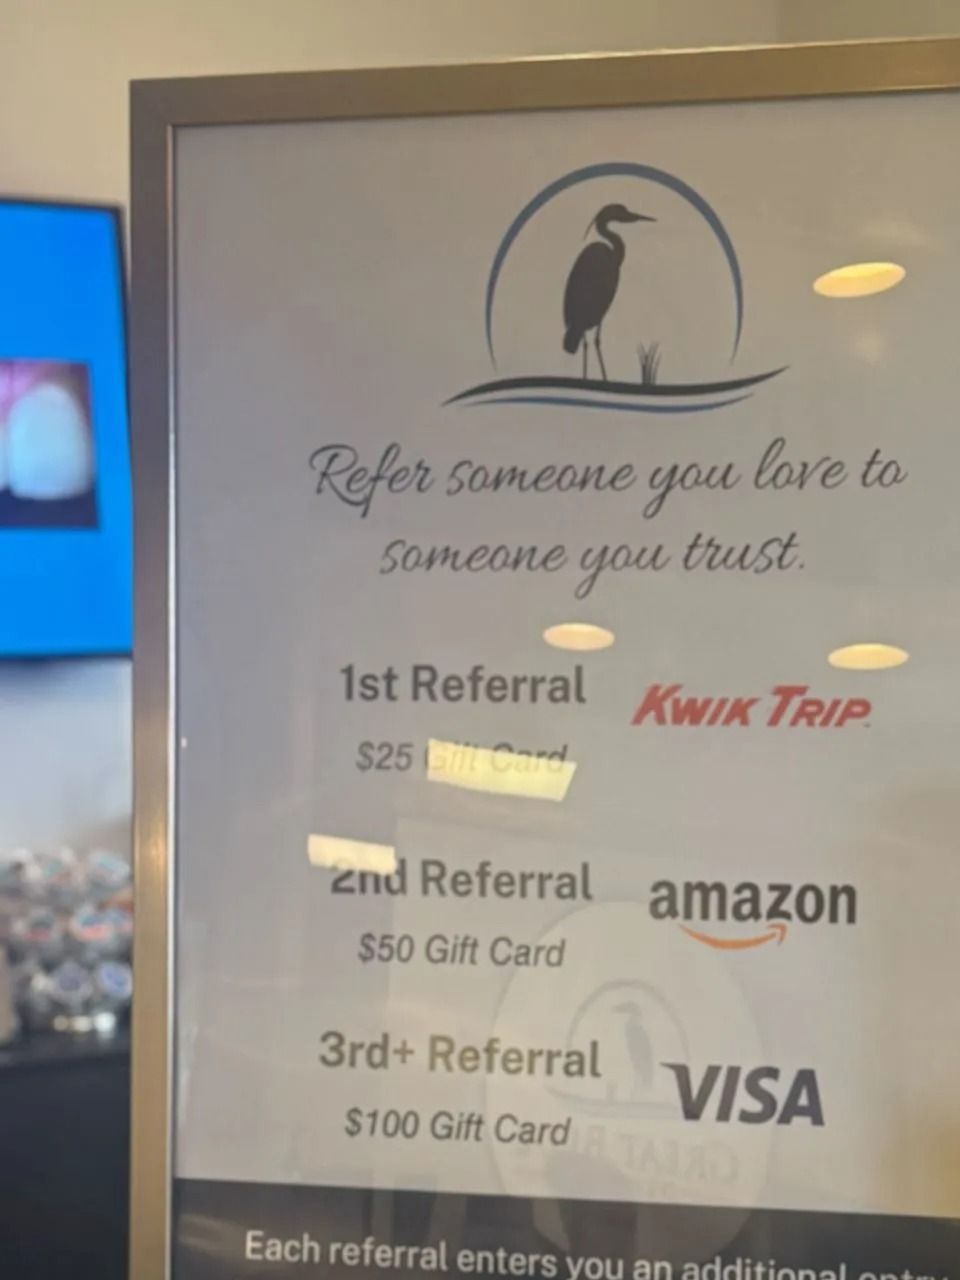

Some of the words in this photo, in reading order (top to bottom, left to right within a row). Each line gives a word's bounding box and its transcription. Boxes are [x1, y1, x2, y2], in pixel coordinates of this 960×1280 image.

[309, 442, 433, 517] Refer
[446, 456, 637, 495] someone
[643, 464, 740, 518] you
[753, 437, 846, 492] love
[861, 448, 907, 491] to
[380, 538, 566, 575] someone
[575, 549, 669, 599] you
[682, 531, 806, 573] trust.
[340, 663, 398, 702] 1st
[412, 665, 586, 704] Referral
[356, 740, 413, 773] $25
[420, 859, 593, 900] Referral
[649, 878, 857, 925] amazon
[357, 932, 414, 965] $50
[425, 935, 479, 966] Gift
[490, 936, 566, 968] Card
[318, 1030, 415, 1070] 3rd+
[428, 1034, 602, 1079] Referral
[659, 1062, 825, 1127] VISA
[344, 1107, 419, 1140] $100
[429, 1110, 484, 1144] Gift
[494, 1114, 571, 1147] Card
[244, 1229, 321, 1265] Each
[328, 1236, 448, 1272] referral
[456, 1245, 558, 1279] enters
